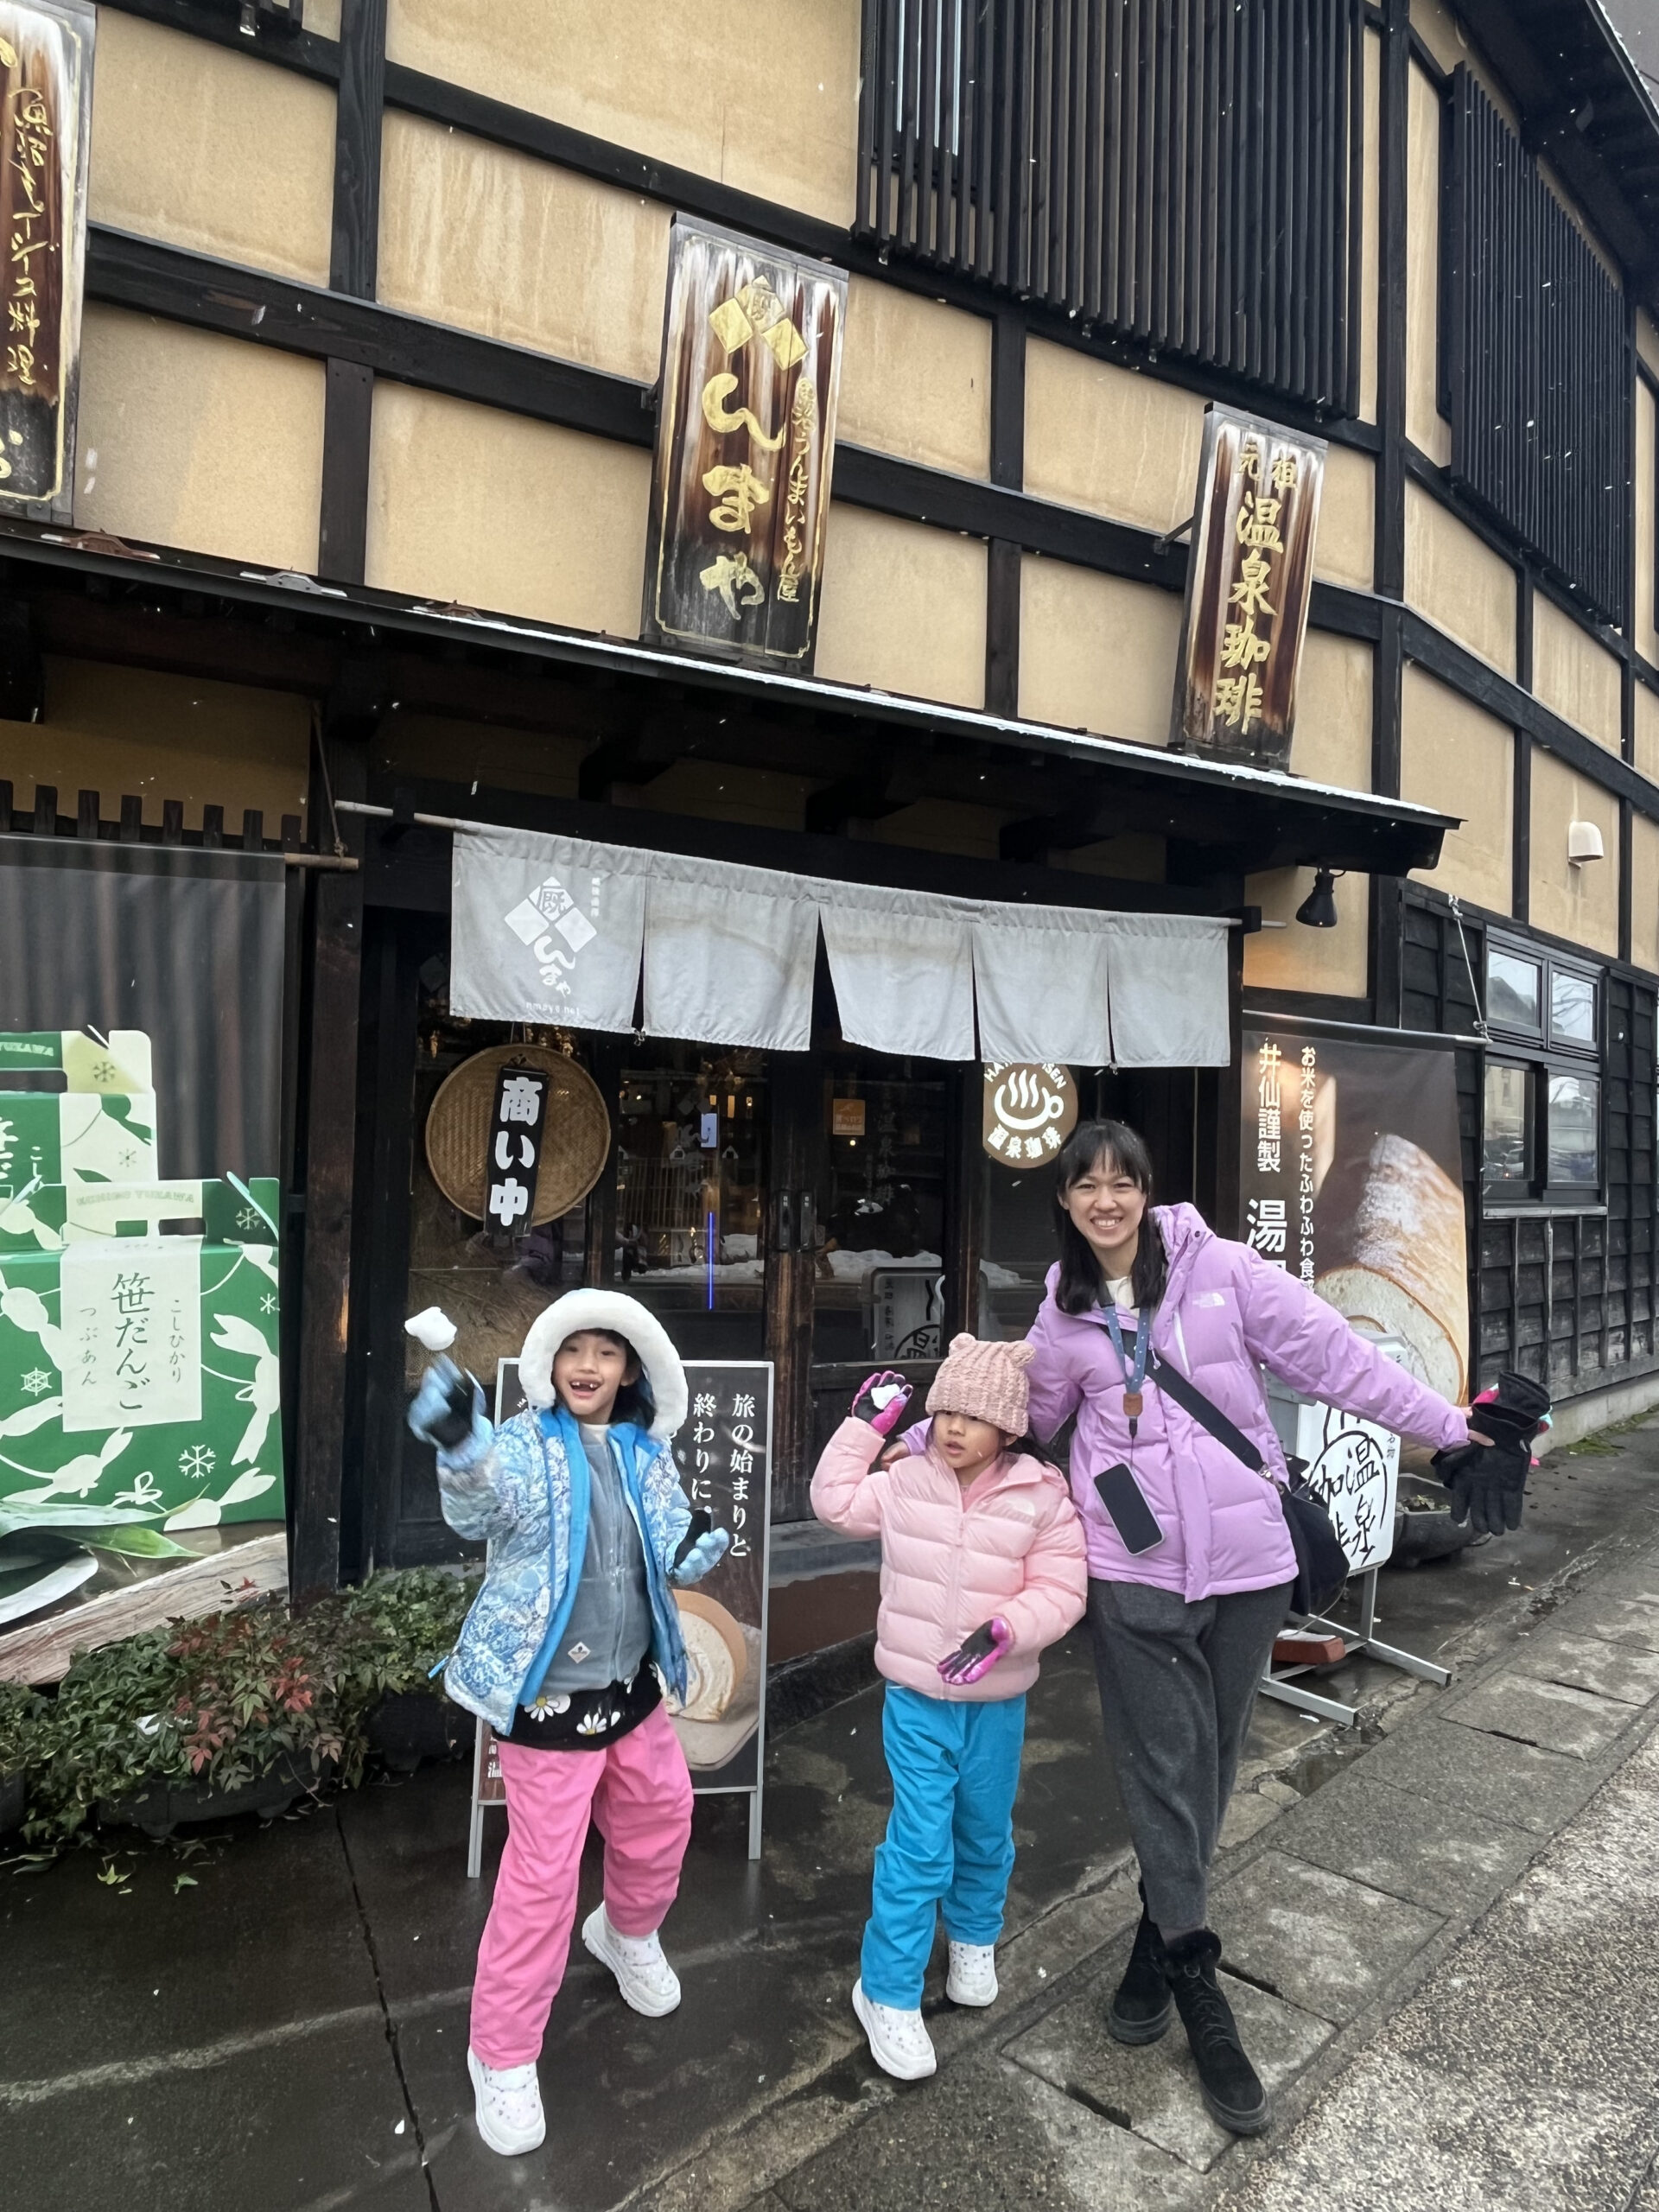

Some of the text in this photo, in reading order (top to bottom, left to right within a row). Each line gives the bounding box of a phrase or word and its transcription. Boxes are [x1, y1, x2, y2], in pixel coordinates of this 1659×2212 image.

[700, 372, 786, 620] んまや
[1238, 442, 1297, 490] 元祖
[1213, 491, 1284, 736] 温泉珈琲
[489, 1077, 543, 1227] 商い中
[1246, 1042, 1287, 1270] 井仙謹製 湯
[79, 1306, 99, 1386] つぶあん
[110, 1271, 156, 1411] 笹だんご
[168, 1299, 187, 1383] こしひかり
[729, 1392, 756, 1558] 旅の始まりと
